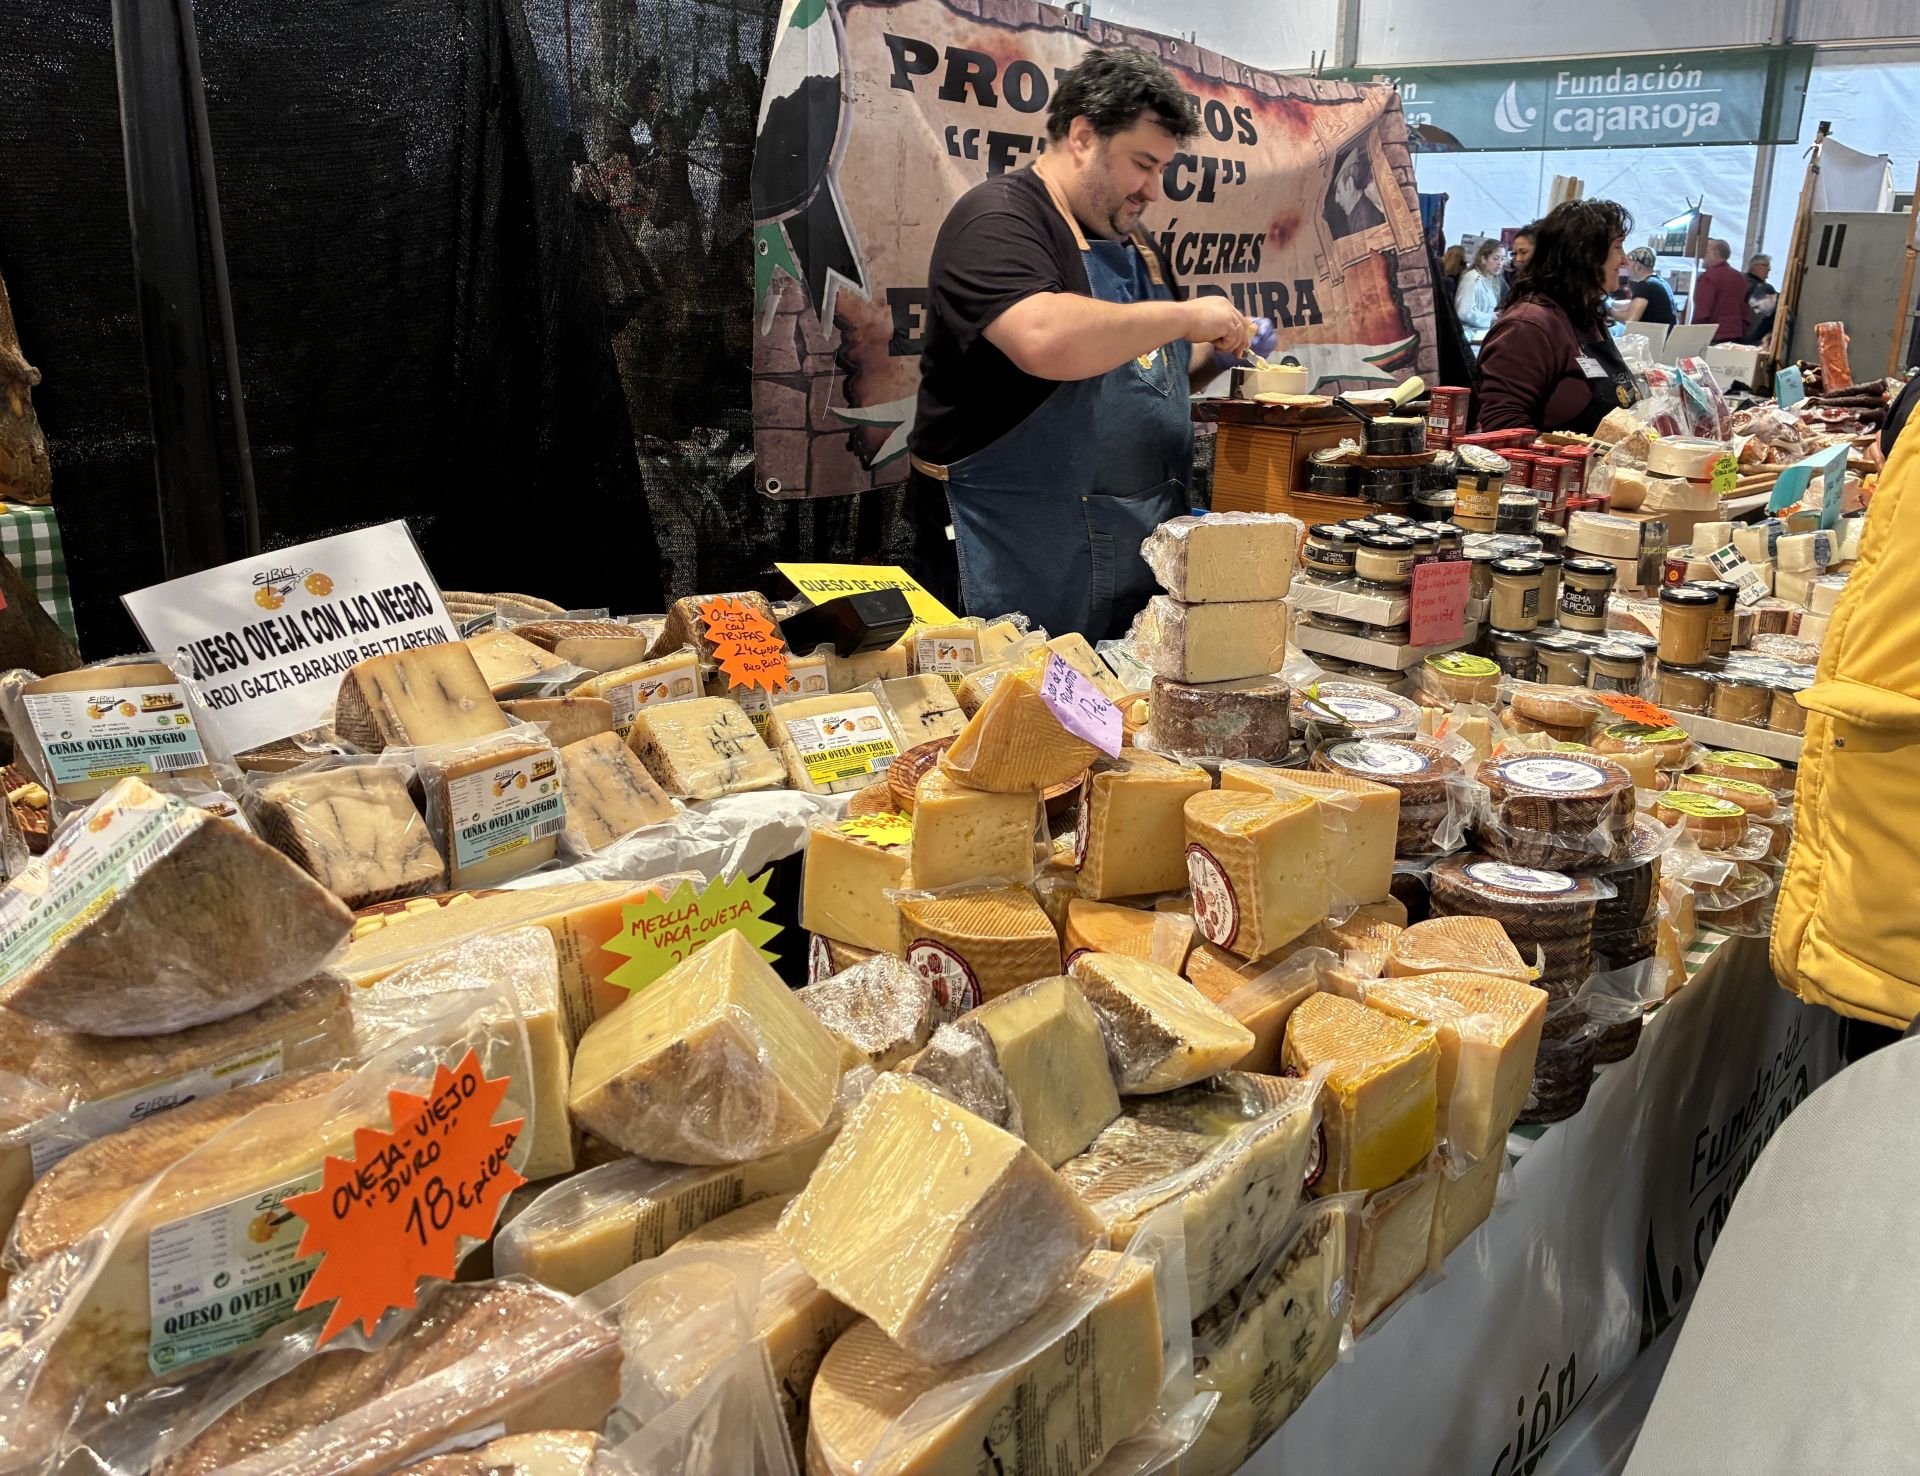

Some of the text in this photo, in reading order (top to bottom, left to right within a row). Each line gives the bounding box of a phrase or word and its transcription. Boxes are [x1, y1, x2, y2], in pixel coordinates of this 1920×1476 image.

[1555, 63, 1703, 95] Fundación
[1150, 217, 1266, 276] ÁCERES
[799, 579, 851, 593] QUESO
[851, 579, 873, 591] DE
[1565, 592, 1591, 604] CREMA
[710, 608, 757, 623] OVEJA
[1568, 600, 1596, 613] PICÓN
[177, 581, 434, 682] QUESO OVEJA CON AJO NEGRO
[202, 683, 244, 711] ARDI
[241, 669, 295, 700] GAZTA
[289, 649, 359, 685] BARAXUR
[47, 731, 187, 756] CUÑAS OVEJA AJO NEGRO
[803, 740, 894, 765] QUESO OVEJA CON TRUFAS
[462, 822, 487, 841] CUÑAS
[488, 814, 514, 831] OVEJA
[515, 808, 531, 822] AJO
[531, 797, 559, 815] NEGRO
[42, 880, 85, 919] OVEJA
[631, 903, 699, 940] MEZCLA
[654, 899, 753, 948] VACA-OVEJA
[405, 1176, 454, 1246] 18
[164, 1302, 223, 1335] QUESO
[229, 1280, 282, 1317] OVEJA
